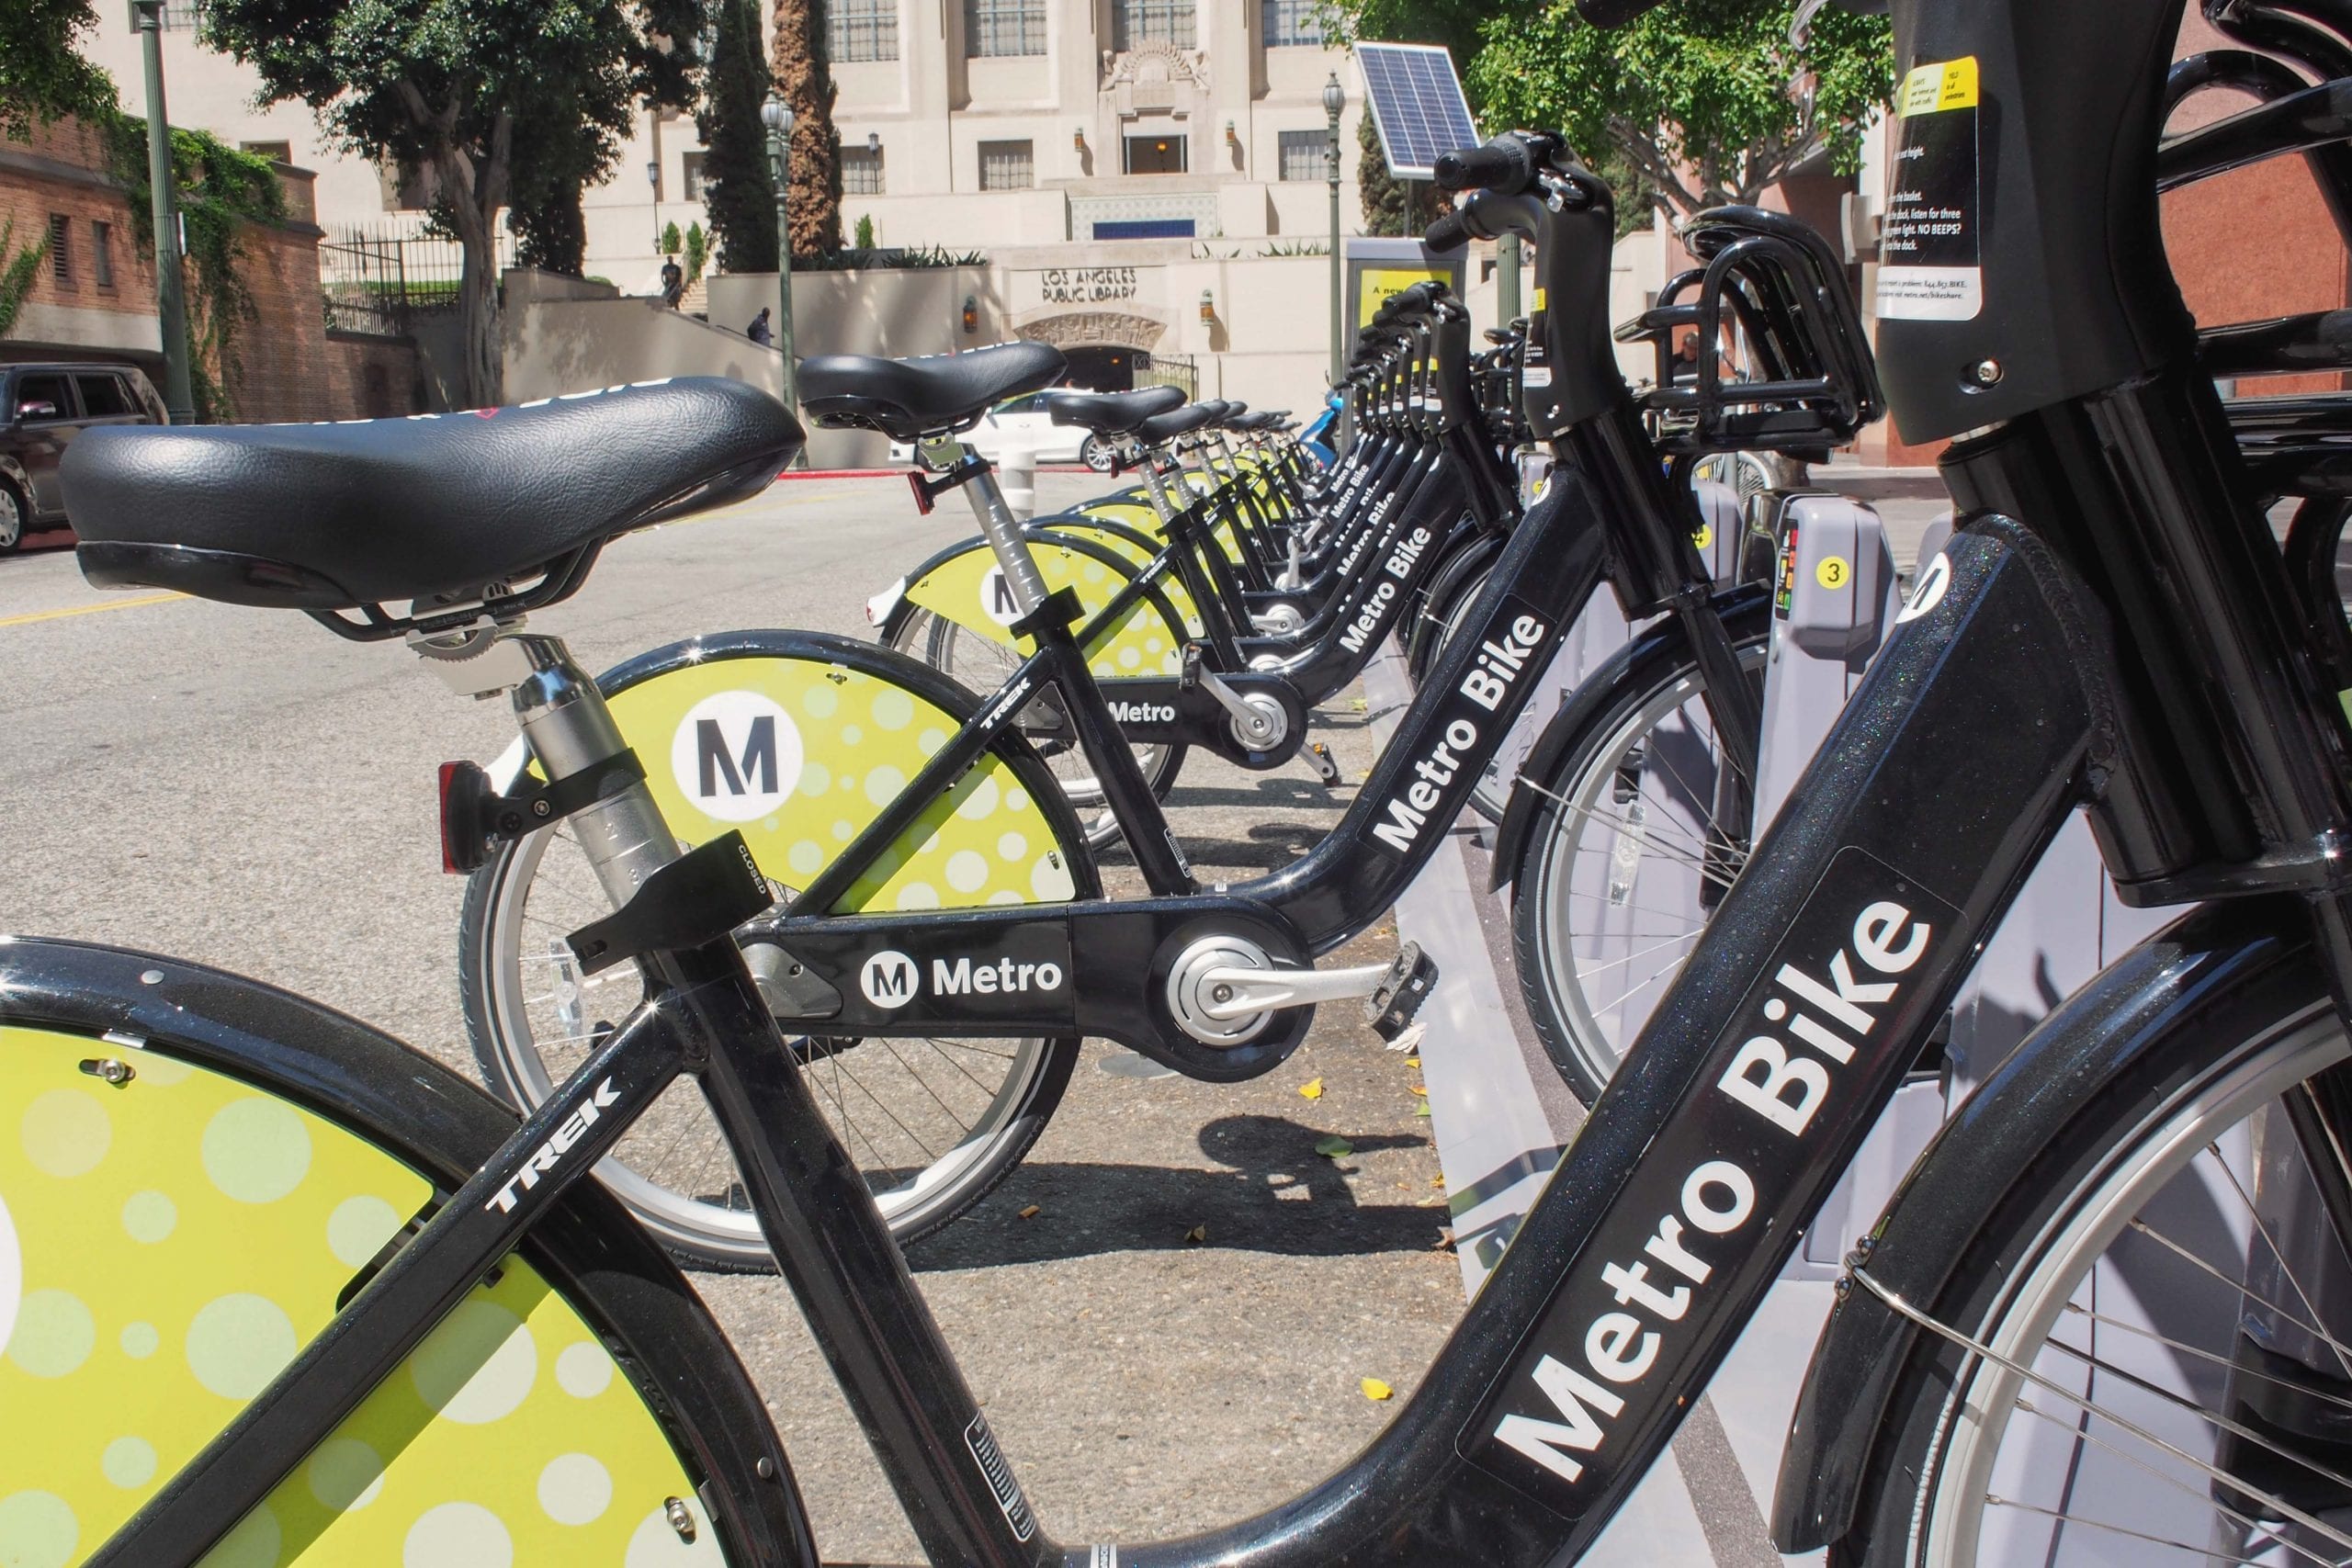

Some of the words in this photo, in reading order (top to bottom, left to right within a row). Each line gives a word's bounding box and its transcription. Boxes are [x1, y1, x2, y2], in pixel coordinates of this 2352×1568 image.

[1911, 208, 1928, 219] listen
[1928, 207, 1939, 220] for
[1940, 208, 1961, 219] three
[1917, 224, 1929, 235] NO
[1931, 223, 1962, 235] BEEPS?
[1042, 271, 1069, 286] LOS
[1077, 268, 1136, 284] ANGELES
[1043, 287, 1085, 302] PUBLIC
[1089, 286, 1136, 301] LIBRARY
[1330, 487, 1355, 519] Metro
[1350, 464, 1370, 488] Bike
[1340, 581, 1396, 653] Metro
[1385, 526, 1431, 580] Bike
[1827, 563, 1840, 582] 3
[979, 677, 1031, 729] TREK
[1108, 702, 1175, 722] Metro
[696, 716, 779, 796] M
[1373, 719, 1477, 853] Metro
[1460, 615, 1545, 712] Bike
[739, 844, 766, 895] CLOSED
[933, 957, 1062, 996] Metro
[485, 1077, 622, 1214] TREK
[1494, 1160, 1756, 1483] Metro
[1717, 900, 1931, 1138] Bike
